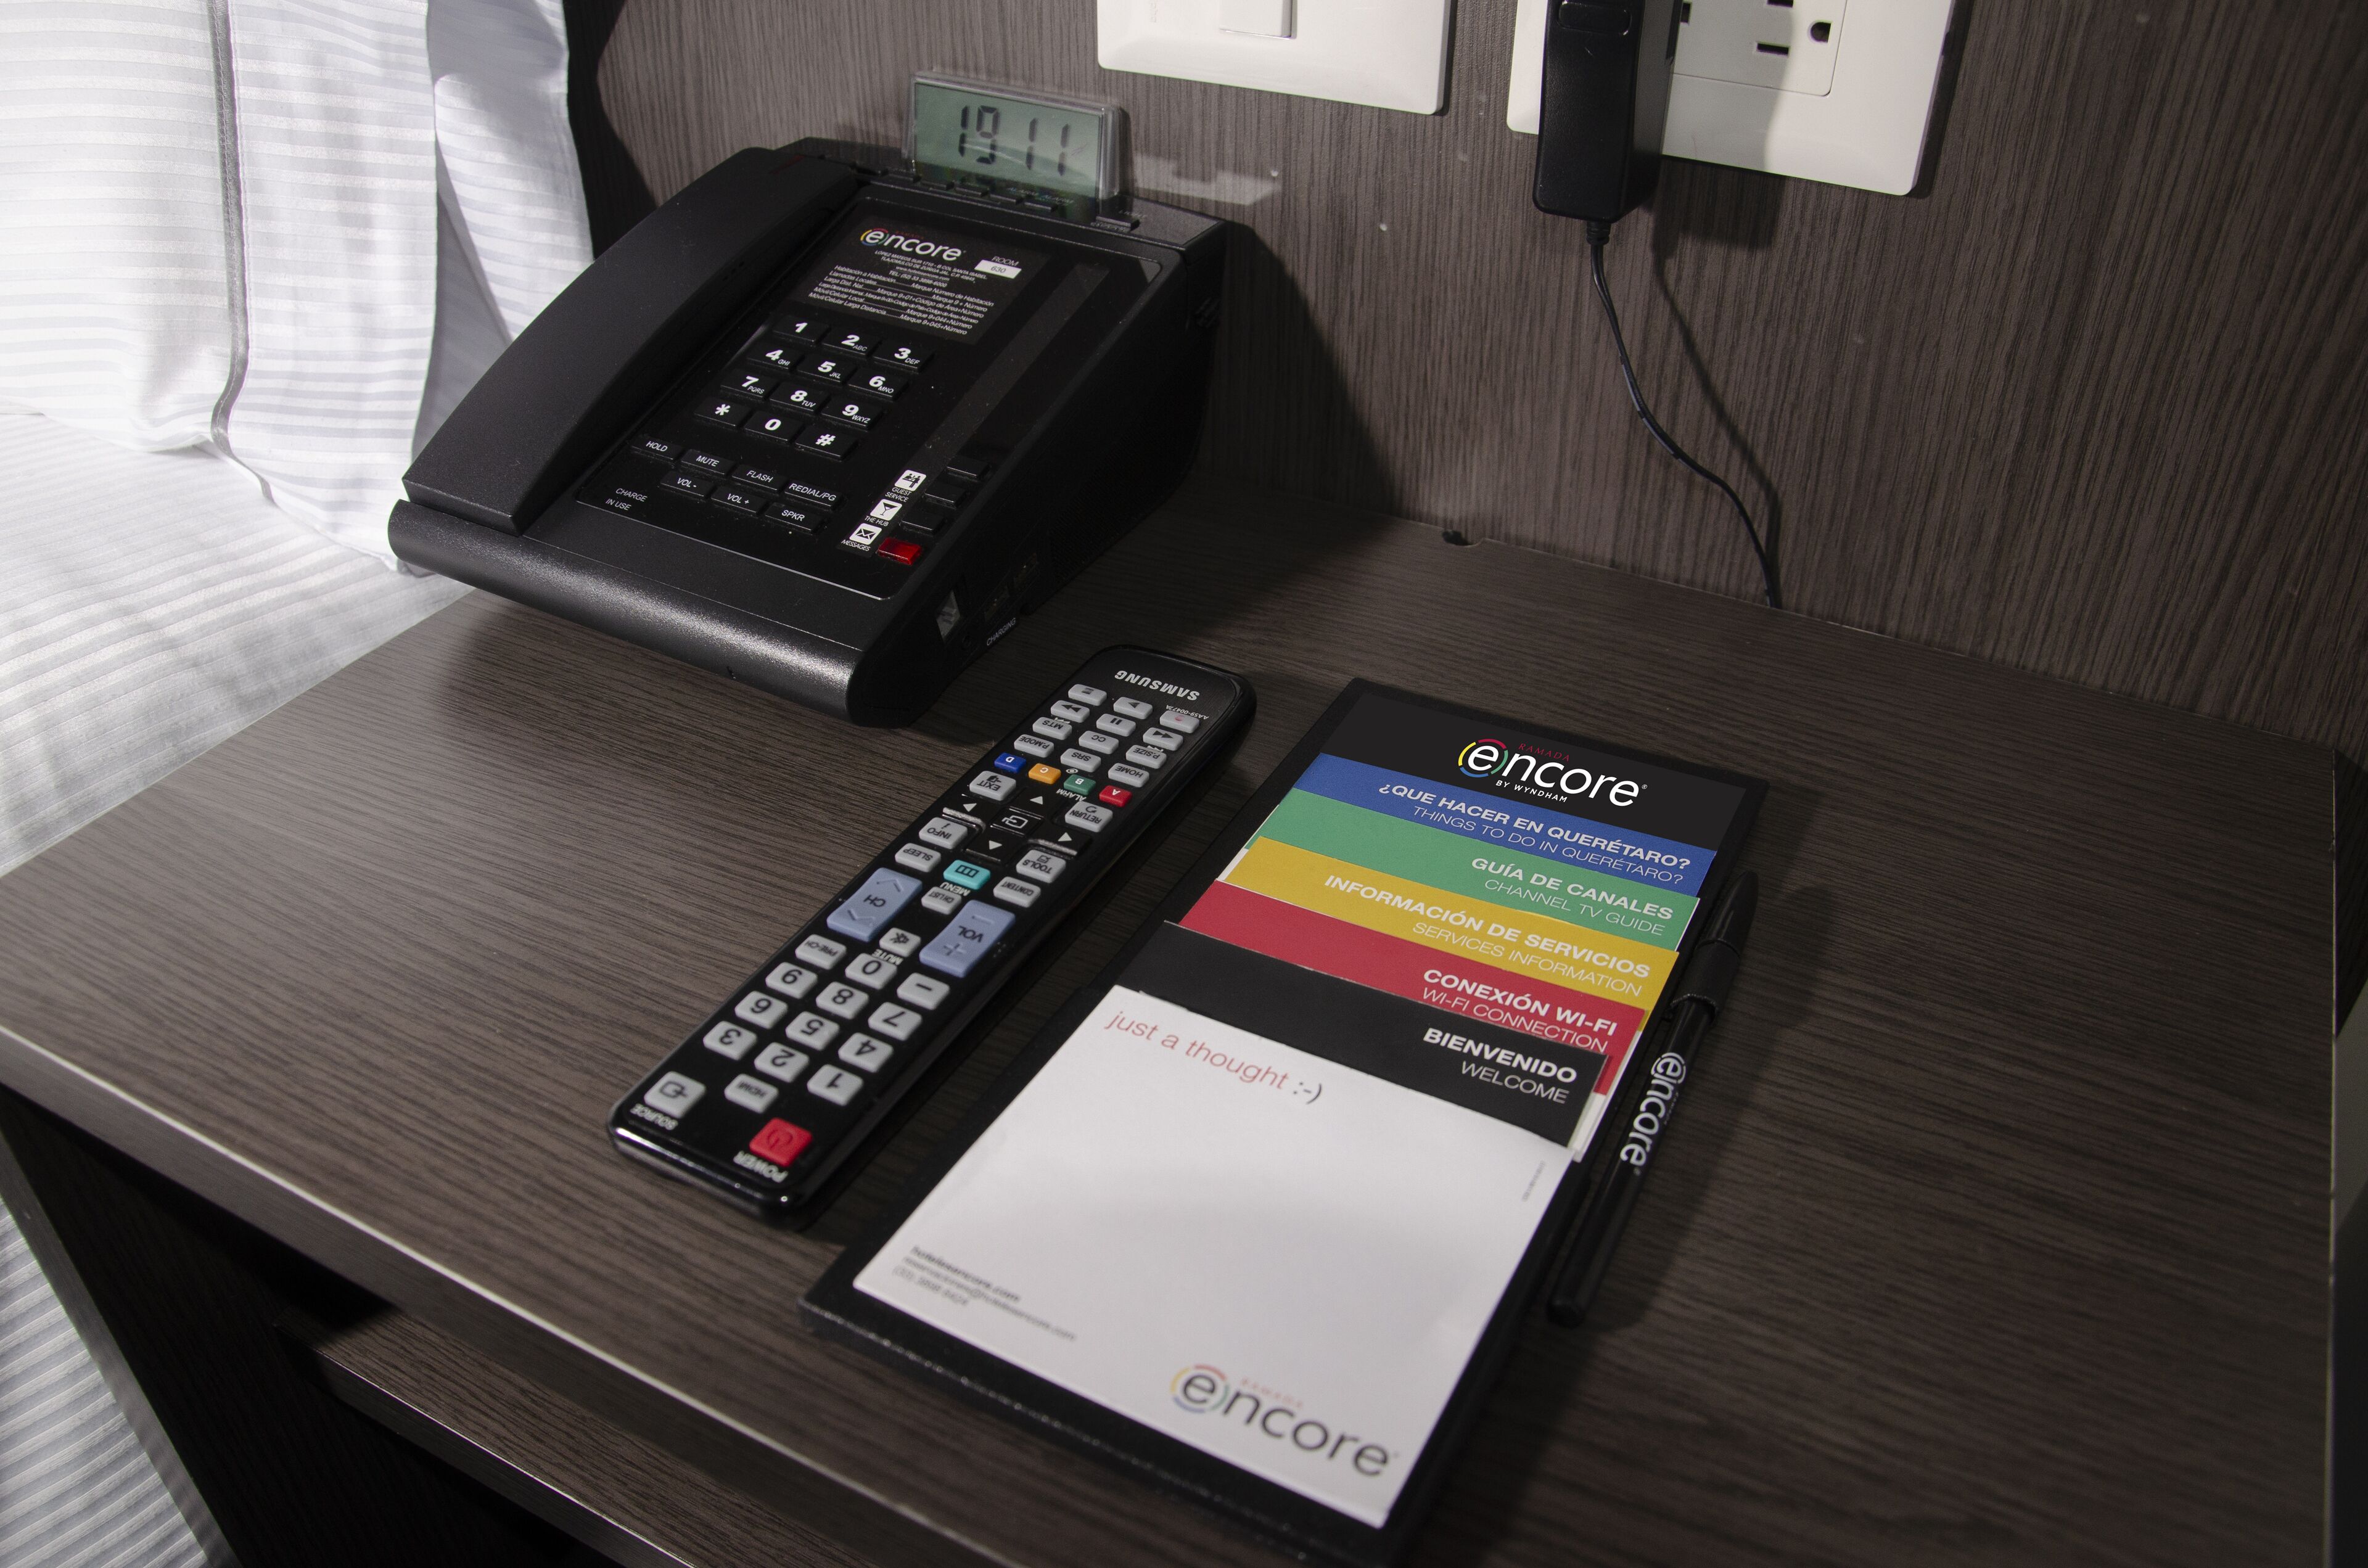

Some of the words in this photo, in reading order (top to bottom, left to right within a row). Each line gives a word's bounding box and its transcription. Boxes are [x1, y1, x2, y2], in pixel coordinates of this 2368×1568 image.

[861, 228, 962, 261] encore
[991, 265, 1006, 273] 630
[992, 256, 1019, 267] ROOM
[796, 322, 808, 332] 1
[841, 334, 860, 347] 2
[852, 343, 867, 352] ABC
[765, 349, 783, 361] 4
[778, 358, 791, 366] GHI
[894, 347, 911, 360] 3
[905, 357, 920, 366] DEF
[818, 361, 836, 372] 5
[741, 376, 758, 387] 7
[869, 376, 886, 388] 6
[878, 385, 894, 394] MNO
[747, 385, 765, 395] PQRS
[791, 390, 808, 402] 8
[802, 400, 816, 408] TUV
[842, 404, 859, 416] 9
[852, 414, 871, 424] WXYZ
[765, 418, 781, 430] 0
[646, 440, 668, 452] HOLD
[815, 433, 835, 446] #
[696, 454, 720, 467] MUTE
[677, 477, 693, 486] VOL
[746, 469, 773, 483] FLASH
[615, 487, 648, 503] CHARGE
[727, 493, 742, 503] VOL
[789, 482, 837, 501] REDIAL/PG
[885, 491, 909, 503] SERVICE
[891, 486, 911, 496] GUEST
[606, 498, 615, 506] IN
[615, 500, 632, 512] USE
[781, 509, 805, 522] SPKR
[864, 515, 876, 523] THE
[876, 519, 889, 527] HUB
[841, 539, 871, 552] MESSAGES
[986, 617, 1017, 647] CHARGING
[1114, 670, 1200, 701] SAMSUNG
[1042, 720, 1064, 730] MTS
[1019, 735, 1050, 750] P.MODE
[1091, 734, 1106, 742] CC
[1071, 752, 1092, 761] SRS
[1132, 747, 1161, 760] P.SIZE
[1518, 742, 1571, 763] RAMADA
[1114, 765, 1144, 778] HOME
[1458, 738, 1640, 807] encore
[977, 780, 1001, 792] EXIT
[1495, 779, 1511, 789] BY
[1514, 784, 1568, 804] WYNDHAM
[1056, 787, 1087, 802] ALARM
[1069, 809, 1103, 824] RETURN
[927, 827, 952, 840] INFO
[1378, 784, 1435, 805] ¿QUE
[1437, 792, 1511, 826] HACER
[1514, 816, 1545, 834] EN
[1547, 826, 1692, 871] QUERÉTARO?
[1413, 805, 1478, 832] THINGS
[1481, 824, 1505, 839] TO
[1508, 831, 1536, 848] DO
[1539, 839, 1559, 854] IN
[1561, 844, 1685, 885] QUERÉTARO?
[903, 848, 934, 861] SLEEP
[1022, 859, 1053, 874] TOOLS
[939, 881, 971, 897] MENU
[1471, 855, 1531, 882] GUÍA
[1532, 872, 1565, 892] DE
[1566, 882, 1674, 921] CANALES
[863, 894, 887, 908] CH
[1484, 878, 1572, 913] CHANNEL
[1579, 903, 1605, 921] TV
[1606, 911, 1667, 938] GUIDE
[957, 926, 984, 943] VOL
[1325, 874, 1485, 932] INFORMACIÓN
[1487, 922, 1521, 943] DE
[1524, 934, 1651, 979] SERVICIOS
[805, 940, 839, 956] PRE-CH
[871, 948, 903, 966] MUTE
[1412, 921, 1505, 958] SERVICES
[1508, 946, 1643, 998] INFORMATION
[863, 960, 881, 975] 0
[781, 968, 803, 985] 9
[832, 988, 854, 1005] 8
[1423, 968, 1550, 1017] CONEXIÓN
[1555, 1010, 1618, 1036] WI-FI
[749, 998, 772, 1014] 6
[802, 1018, 824, 1035] 5
[882, 1011, 906, 1028] 7
[1422, 986, 1471, 1013] WI-FI
[1473, 1003, 1609, 1053] CONNECTION
[719, 1028, 741, 1045] 3
[855, 1040, 876, 1056] 4
[1104, 1011, 1159, 1041] just
[1161, 1033, 1180, 1050] a
[1185, 1040, 1289, 1090] thought
[1422, 1027, 1577, 1083] BIENVENIDO
[771, 1049, 796, 1067] 2
[826, 1072, 843, 1088] 1
[1461, 1060, 1570, 1104] WELCOME
[630, 1103, 678, 1130] SOURCE
[1619, 1052, 1687, 1167] encore
[733, 1149, 789, 1183] POWER
[1169, 1363, 1389, 1477] encore
